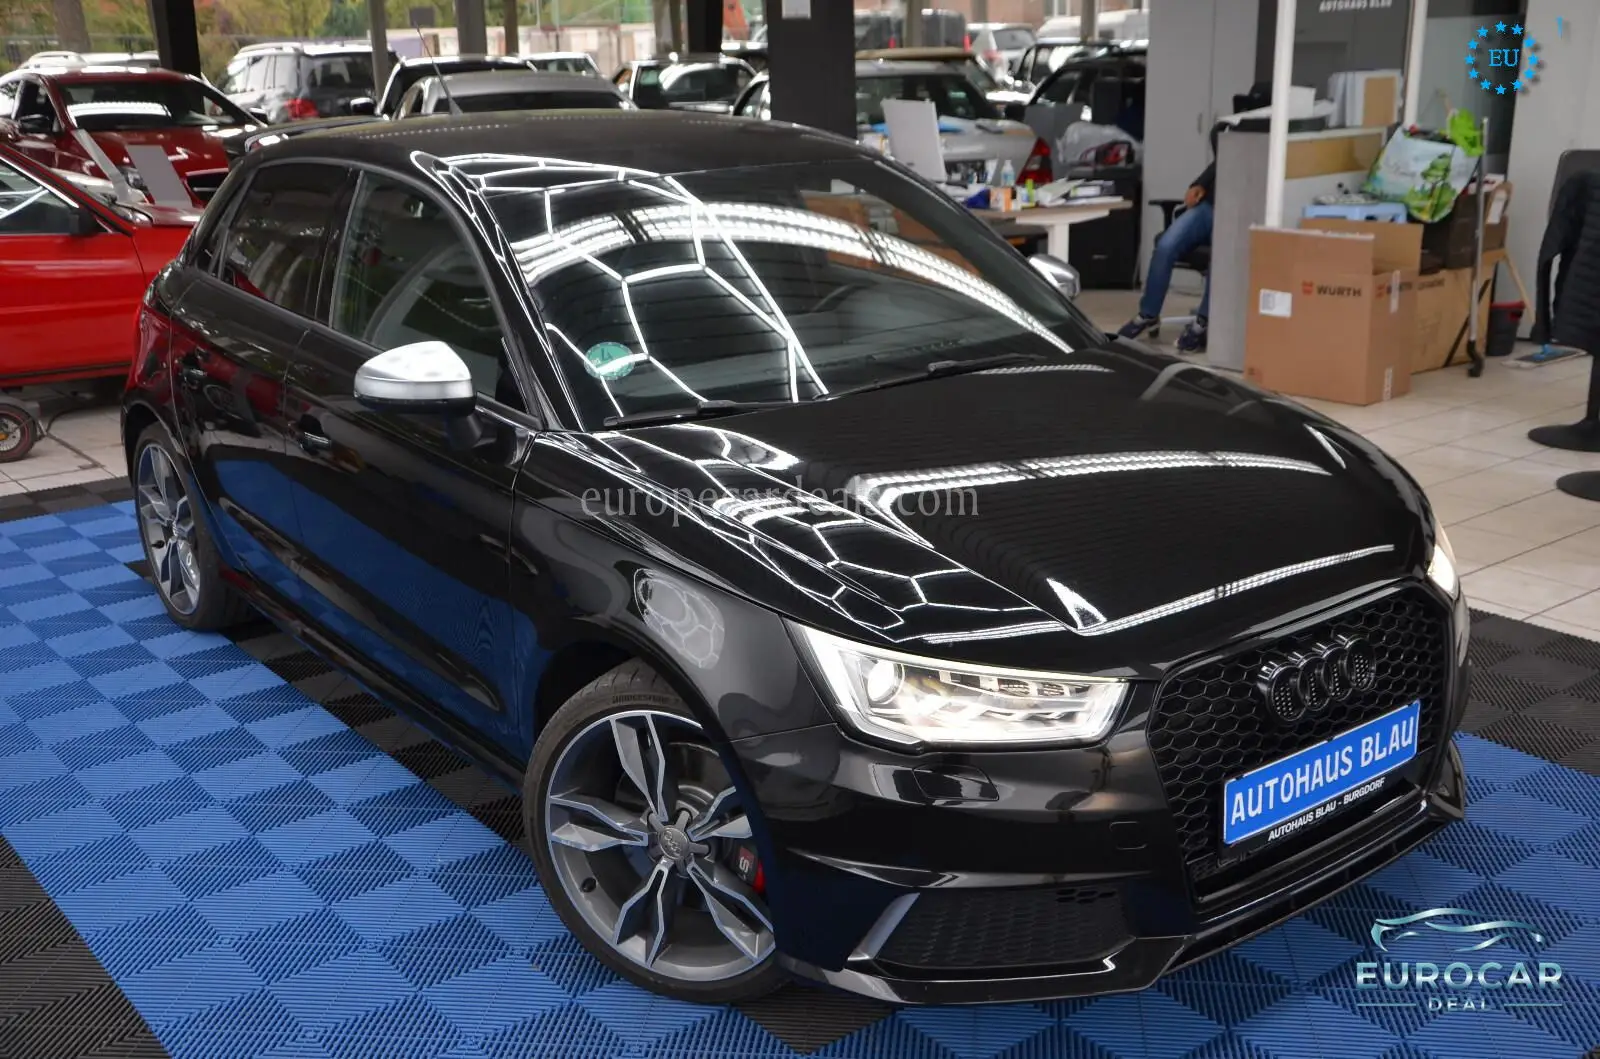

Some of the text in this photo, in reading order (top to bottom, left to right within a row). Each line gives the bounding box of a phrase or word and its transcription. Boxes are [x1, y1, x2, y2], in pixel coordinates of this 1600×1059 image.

[1230, 716, 1414, 826] AUTOHAUS BLAU
[1268, 812, 1314, 842] AUTOHAUS
[1315, 800, 1336, 820] BLAU
[1343, 777, 1385, 805] BURGDORF
